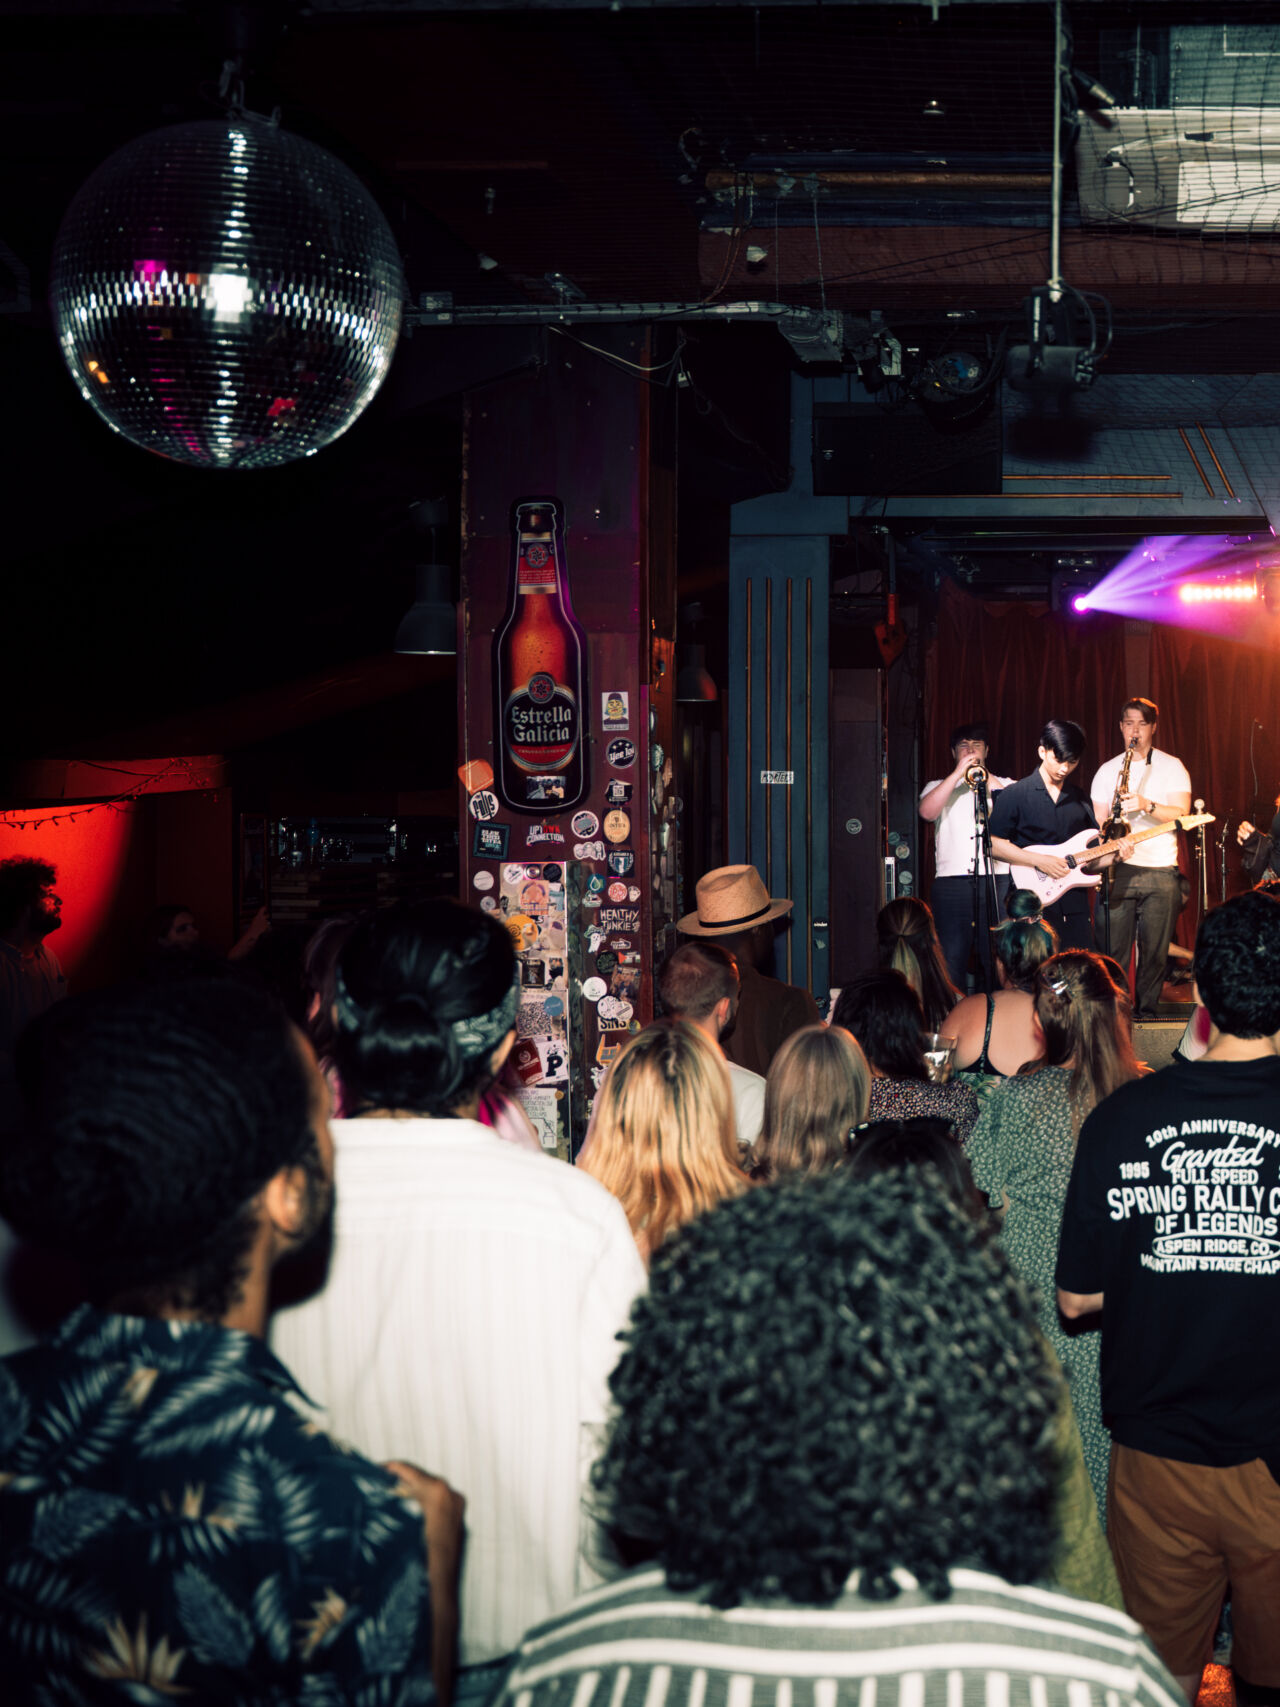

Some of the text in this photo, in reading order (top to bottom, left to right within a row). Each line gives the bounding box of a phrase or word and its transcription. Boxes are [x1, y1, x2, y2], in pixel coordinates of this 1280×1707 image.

[510, 705, 572, 724] Estrella
[513, 724, 570, 743] Galicia
[600, 908, 639, 921] HEALTHY
[546, 1055, 562, 1077] P
[1161, 1135, 1265, 1172] Granted
[1119, 1161, 1150, 1180] 1995
[1171, 1167, 1259, 1185] FULL SPEED
[1107, 1184, 1187, 1221] SPRING
[1194, 1184, 1265, 1214] RALLY
[1155, 1212, 1278, 1236] OF LEGENDS
[1155, 1239, 1202, 1255] ASPEN
[1198, 1257, 1243, 1273] STAGE
